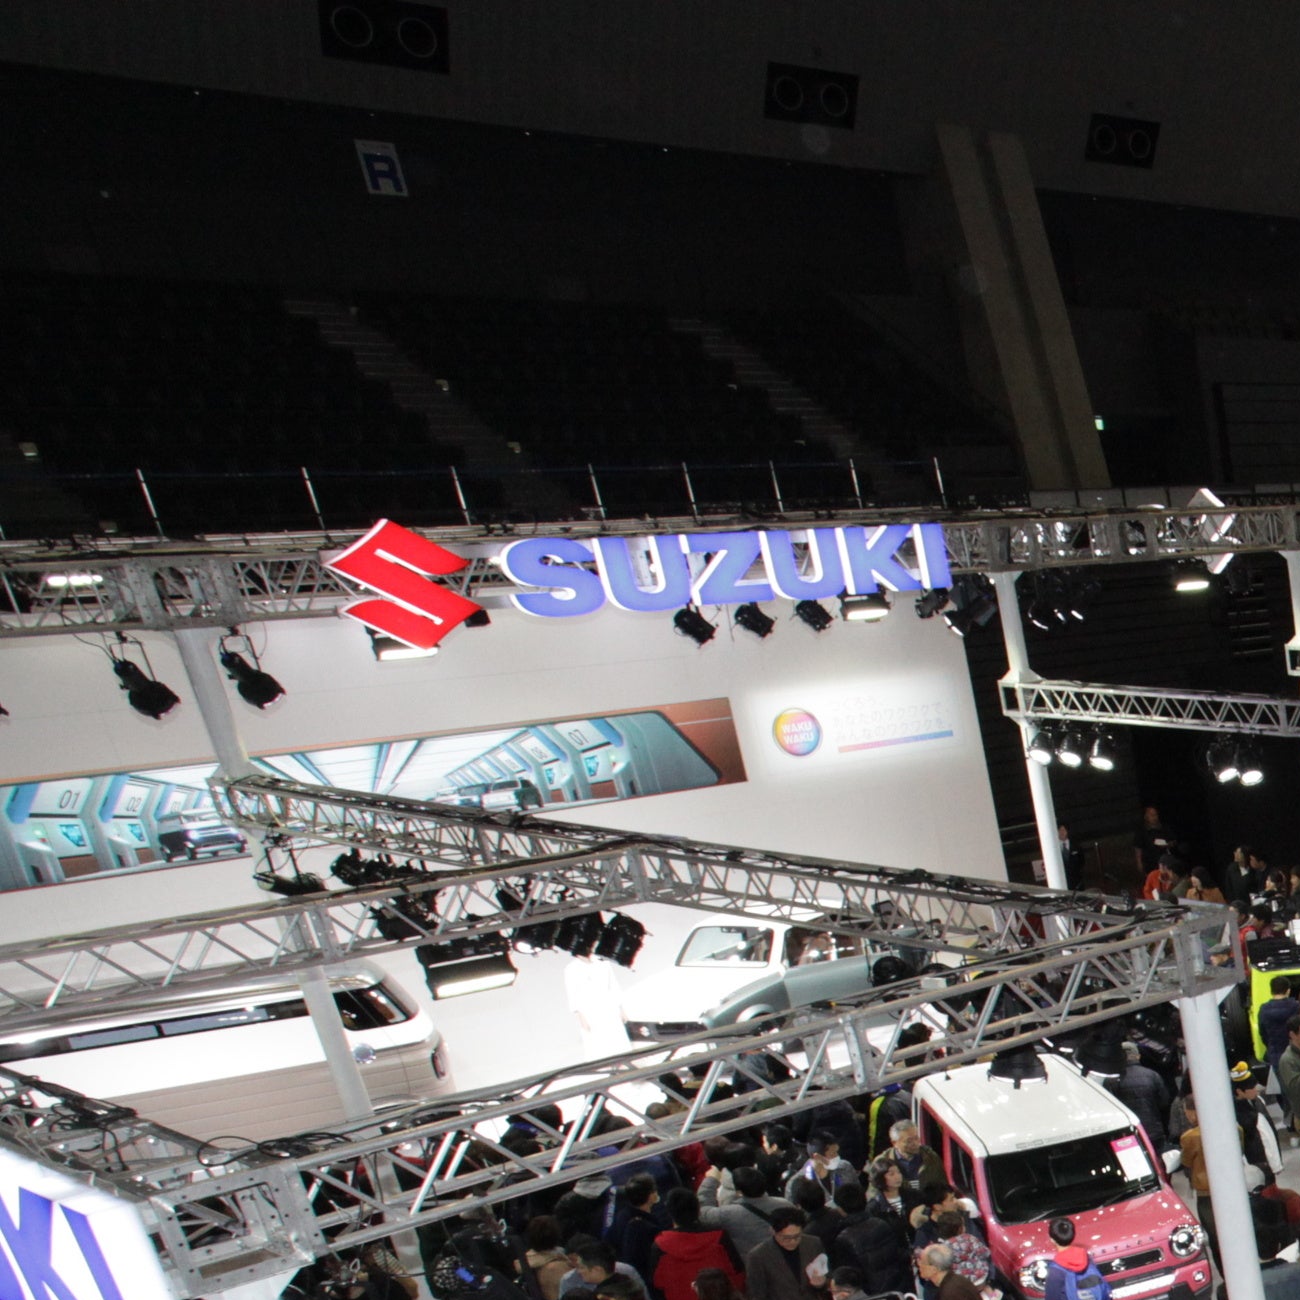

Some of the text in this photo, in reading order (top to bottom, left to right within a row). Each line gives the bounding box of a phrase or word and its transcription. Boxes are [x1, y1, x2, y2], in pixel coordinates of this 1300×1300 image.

[362, 152, 403, 193] R
[500, 523, 952, 617] SUZUKI
[782, 721, 813, 734] WAKU
[784, 731, 815, 745] WAKU
[59, 789, 80, 809] 01
